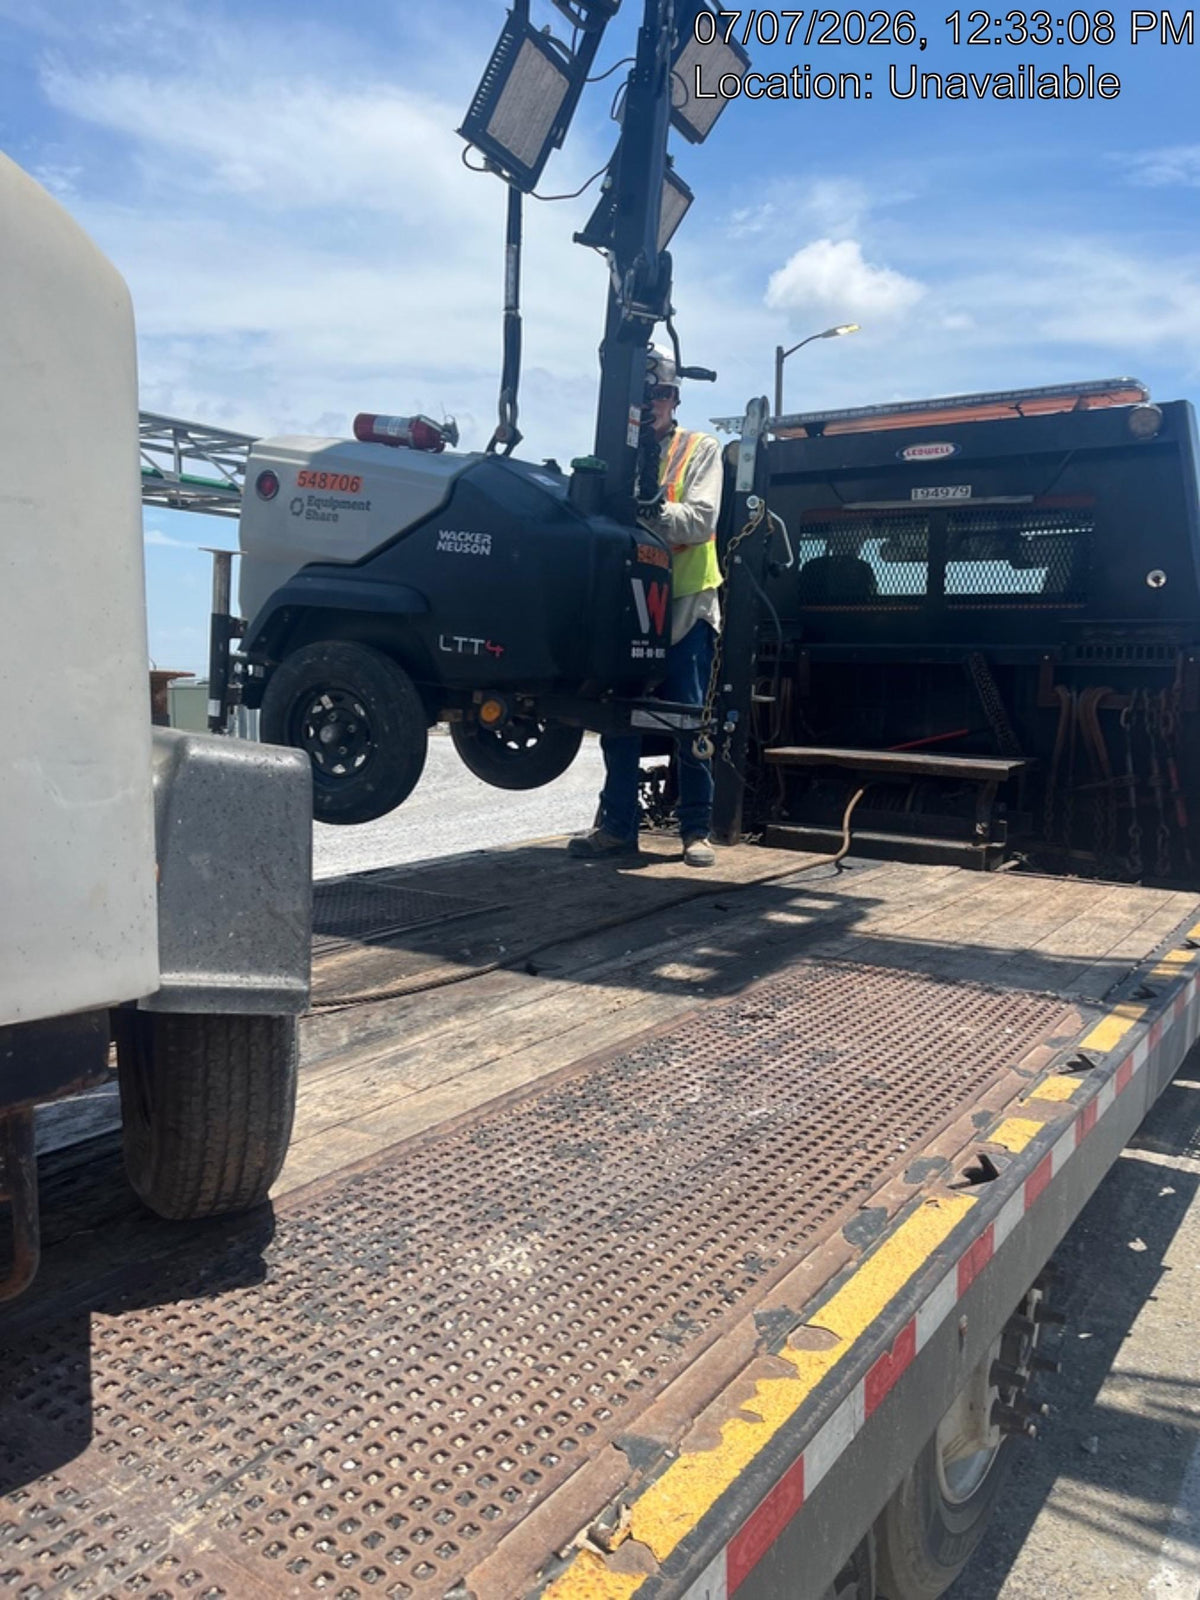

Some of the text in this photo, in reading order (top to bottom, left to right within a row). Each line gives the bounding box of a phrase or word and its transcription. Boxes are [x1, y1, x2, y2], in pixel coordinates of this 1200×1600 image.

[297, 470, 361, 493] 548706
[306, 495, 371, 512] Equipment
[305, 509, 339, 523] Share
[438, 529, 492, 545] WACKER
[436, 541, 492, 556] NEUSON
[439, 634, 504, 658] LTT4
